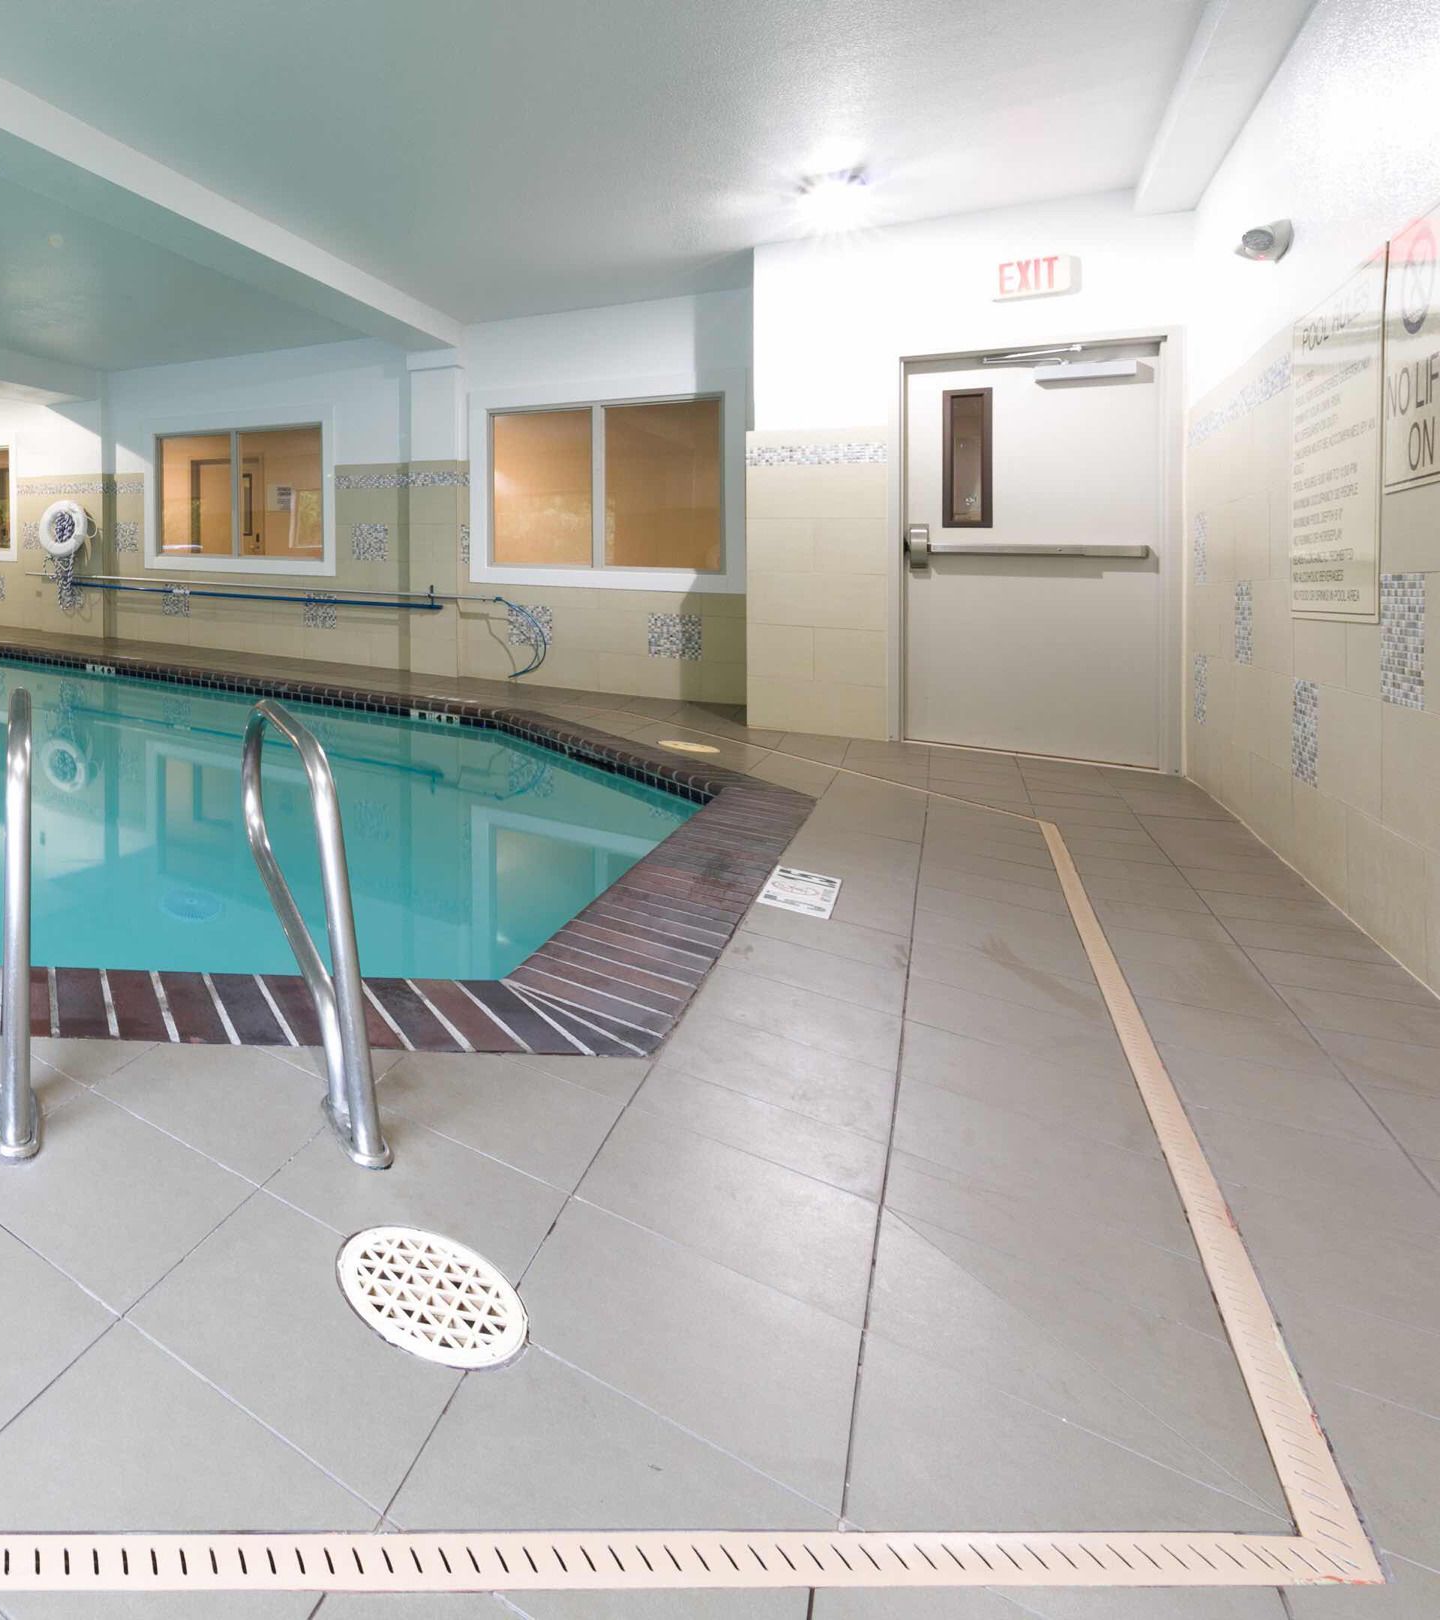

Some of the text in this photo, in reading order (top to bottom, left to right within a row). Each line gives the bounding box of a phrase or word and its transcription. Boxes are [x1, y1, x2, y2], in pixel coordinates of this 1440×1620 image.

[998, 256, 1059, 296] EXIT
[1302, 309, 1329, 357] POOL
[1387, 367, 1410, 420] NO
[1408, 417, 1435, 471] ON
